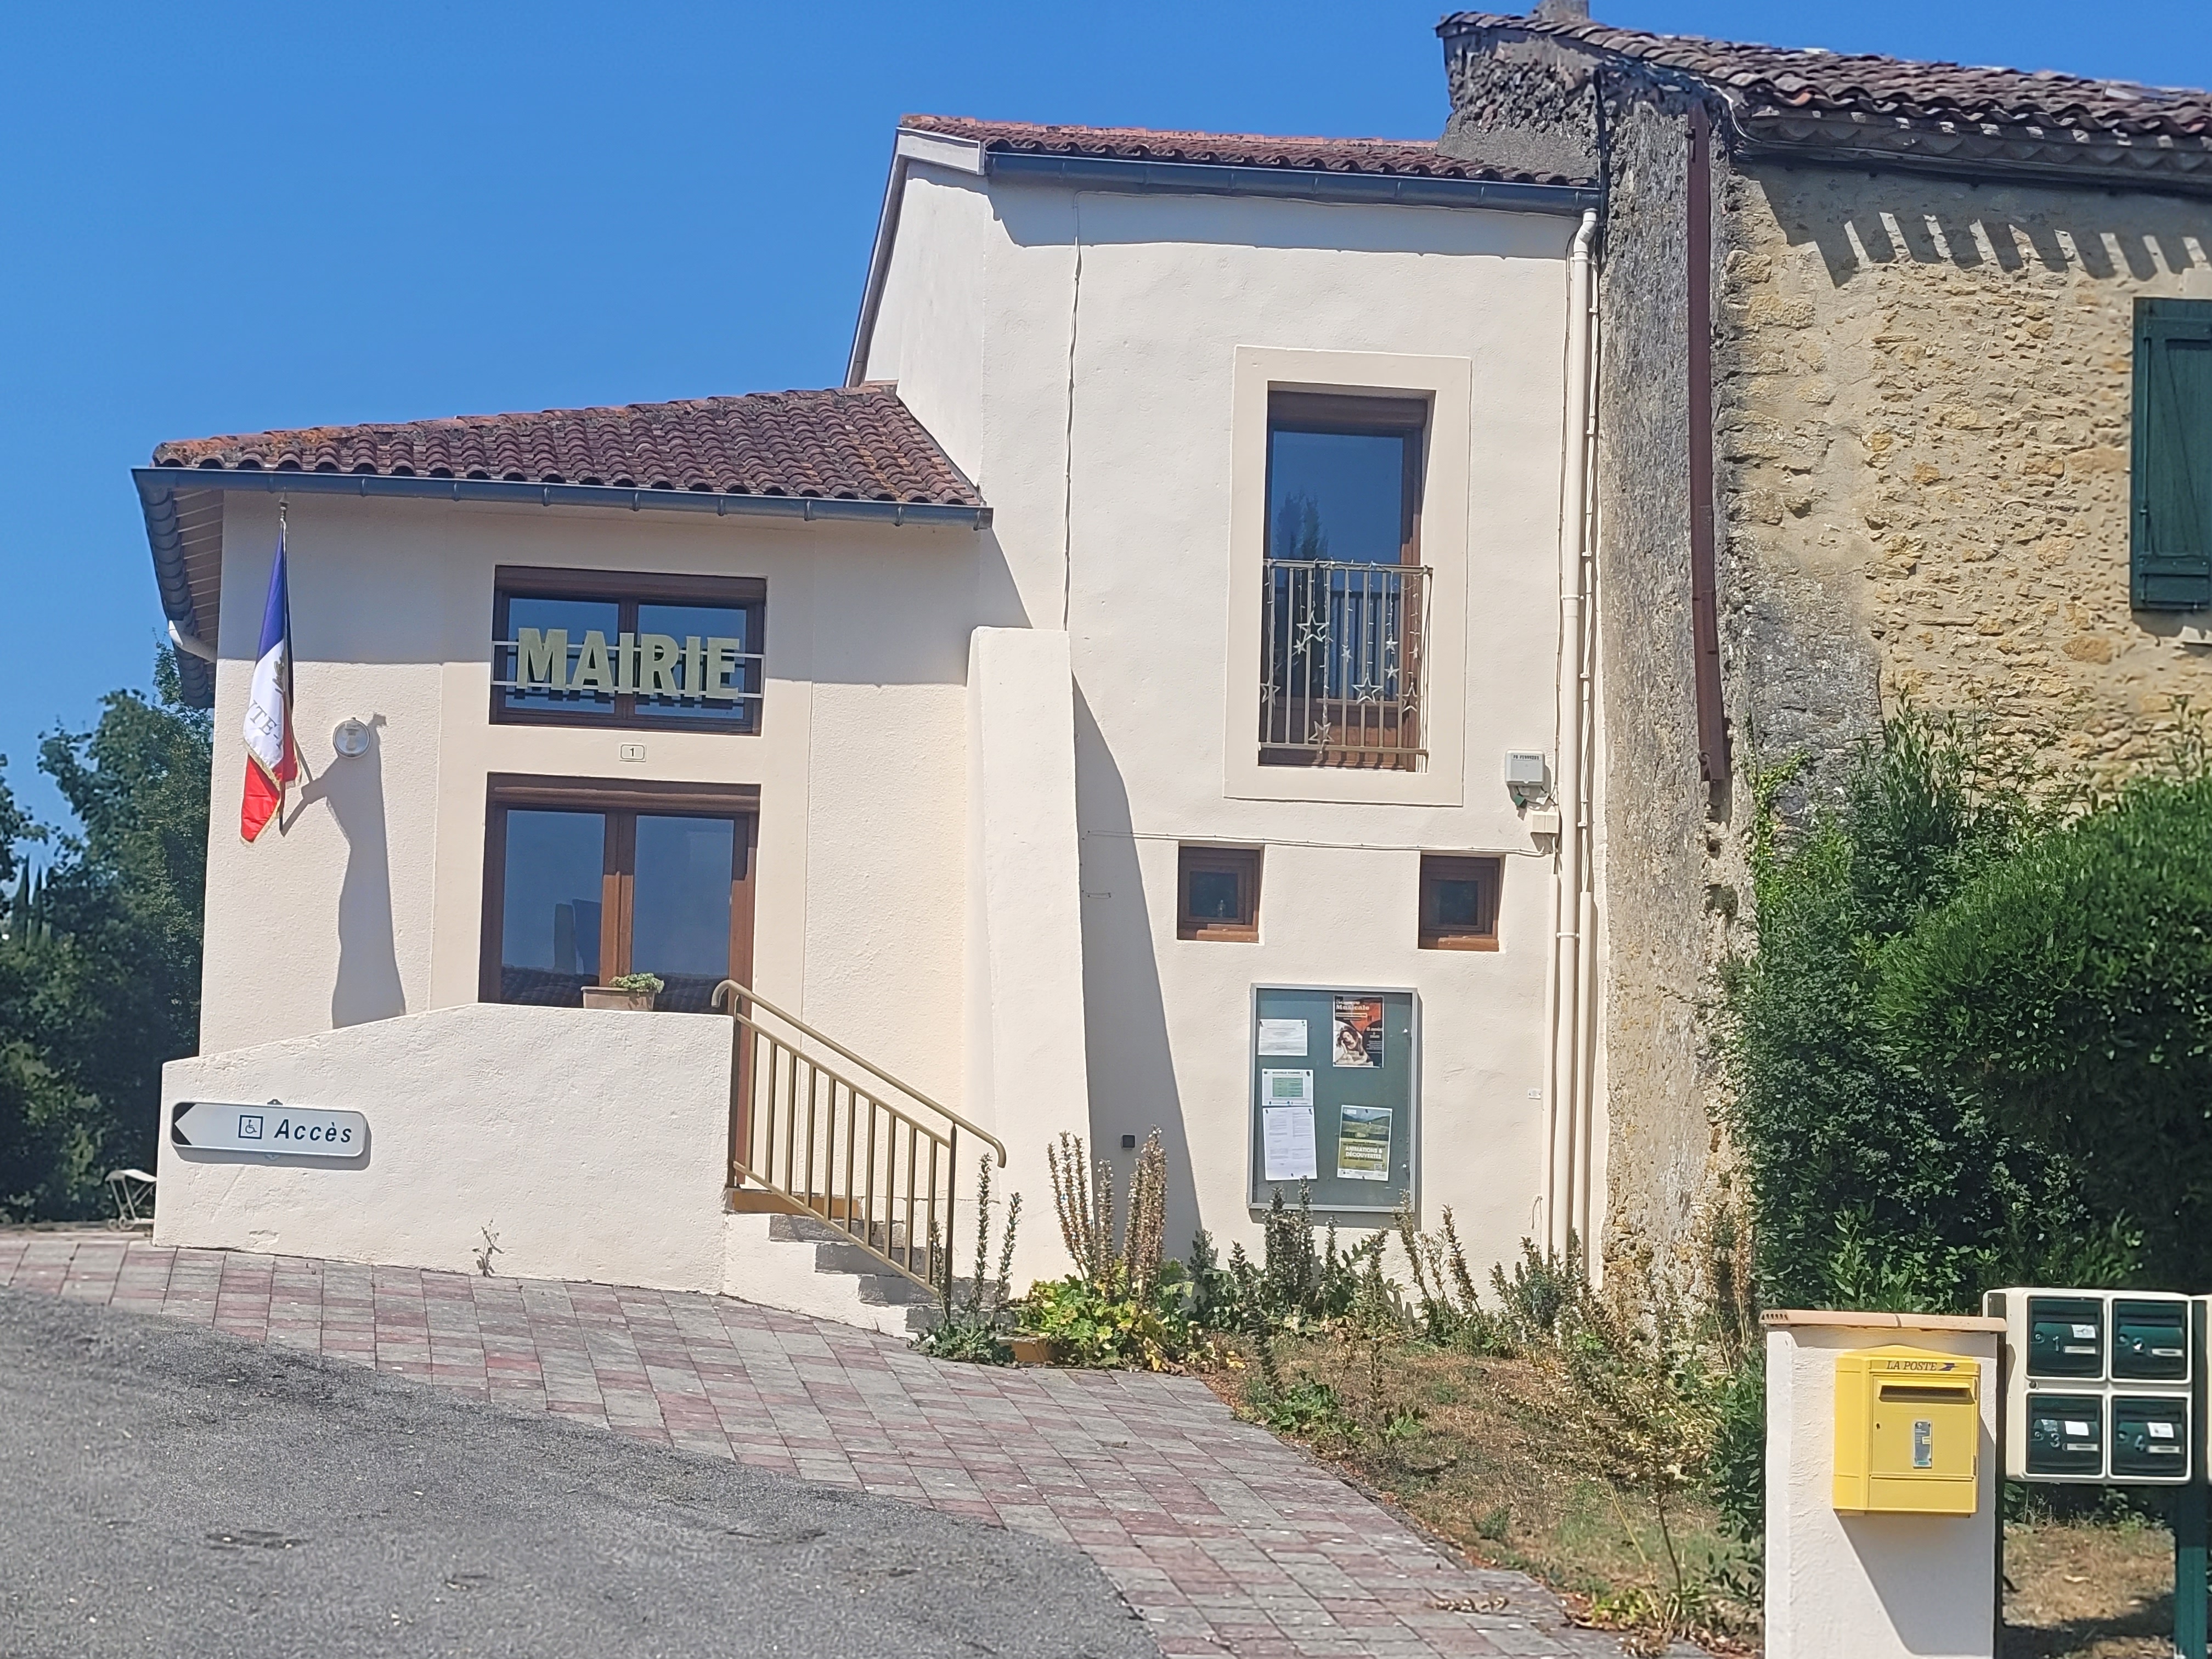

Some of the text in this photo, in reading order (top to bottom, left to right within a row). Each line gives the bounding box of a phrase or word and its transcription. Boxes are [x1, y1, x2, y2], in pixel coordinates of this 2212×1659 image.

[516, 627, 740, 699] MAIRIE
[629, 747, 634, 757] 1
[274, 1119, 352, 1143] Accès
[1887, 1360, 1938, 1371] LA POSTE
[2050, 1432, 2060, 1448] 3
[2134, 1435, 2146, 1451] 4
